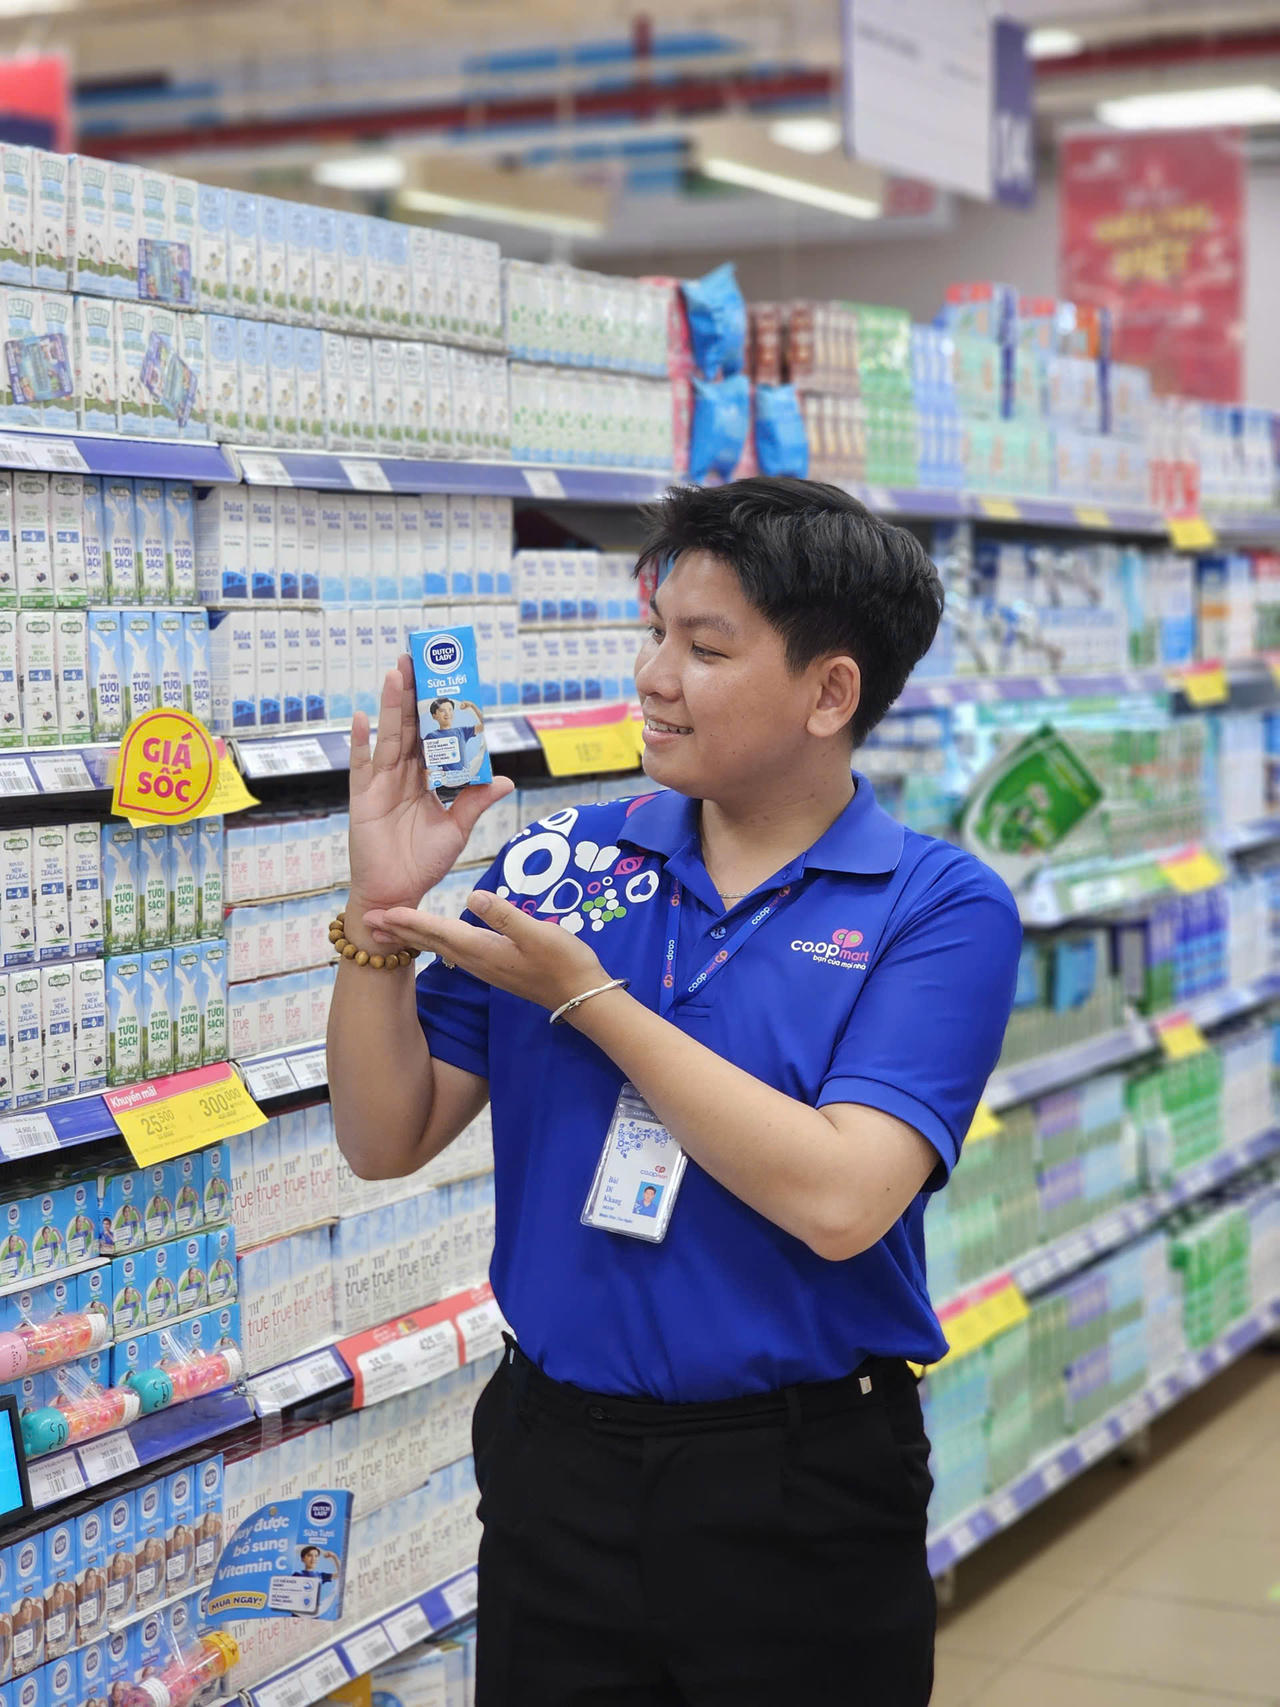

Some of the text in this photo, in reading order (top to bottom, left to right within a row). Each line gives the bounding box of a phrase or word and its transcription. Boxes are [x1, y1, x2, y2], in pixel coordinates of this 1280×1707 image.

[432, 647, 455, 657] DUTCH
[436, 655, 453, 663] LADY
[428, 677, 447, 688] Sữa
[143, 731, 193, 769] GIÁ
[137, 767, 192, 803] SỐC
[109, 1085, 158, 1108] Khuyến mãi
[284, 1175, 307, 1195] true
[310, 1168, 334, 1186] true
[232, 1192, 254, 1211] rue
[257, 1183, 281, 1202] true
[372, 1268, 394, 1287] true
[397, 1260, 419, 1279] true
[345, 1277, 369, 1297] true
[271, 1304, 292, 1326] true
[294, 1295, 312, 1316] true
[247, 1315, 269, 1336] true
[361, 1460, 382, 1479] true
[335, 1471, 357, 1488] true
[226, 1504, 239, 1520] TH
[254, 1516, 290, 1533] được
[233, 1538, 289, 1557] bổ sung
[218, 1556, 287, 1580] Vitamin C
[211, 1598, 231, 1610] MUA
